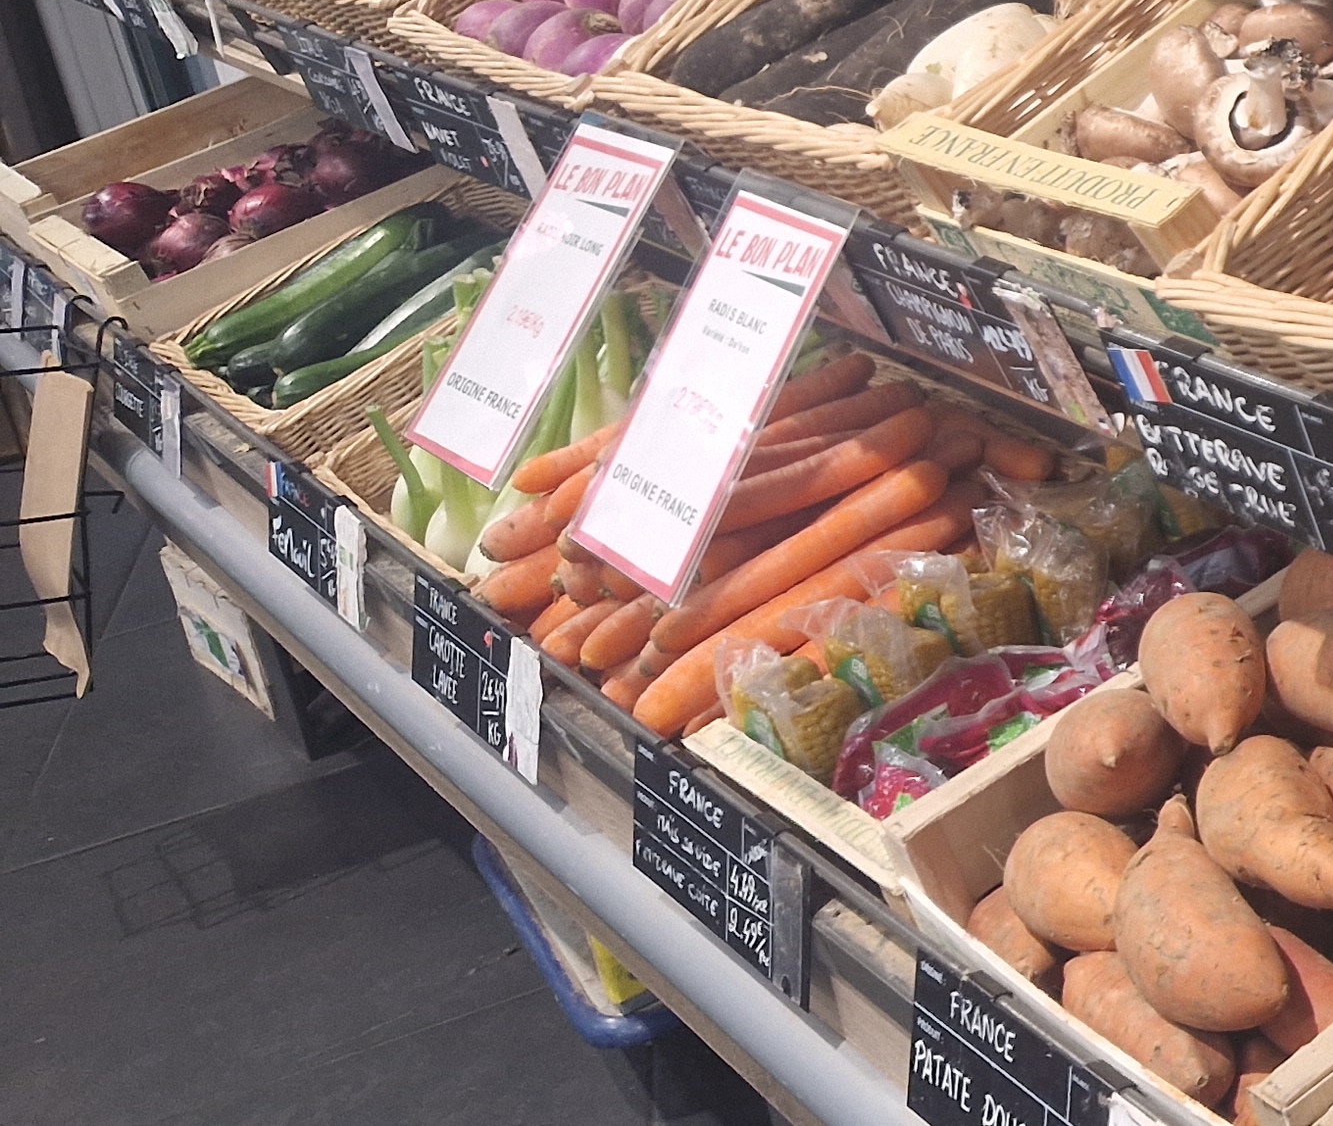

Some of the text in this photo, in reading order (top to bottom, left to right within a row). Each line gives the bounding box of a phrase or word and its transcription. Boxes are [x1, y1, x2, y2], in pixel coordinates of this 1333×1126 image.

[413, 77, 472, 116] FRANCE
[909, 124, 1016, 169] FRANCE
[554, 162, 581, 190] LE
[574, 165, 606, 196] BON
[602, 171, 650, 202] PLAN
[1029, 164, 1161, 211] PRODUIT
[715, 227, 825, 279] LE BON PLAN
[872, 242, 959, 299] FRANCE
[708, 298, 769, 336] RADIS BLANC
[906, 316, 933, 347] DE
[447, 371, 523, 420] ORIGINE FRANCE
[611, 462, 699, 527] ORIGINE FRANCE
[429, 586, 458, 625] FRANCE
[428, 625, 467, 679] CAROTTE
[487, 719, 502, 747] KG
[668, 770, 725, 830] FRANCE
[949, 990, 1017, 1064] FRANCE
[913, 1039, 1028, 1126] PATATE DOU
